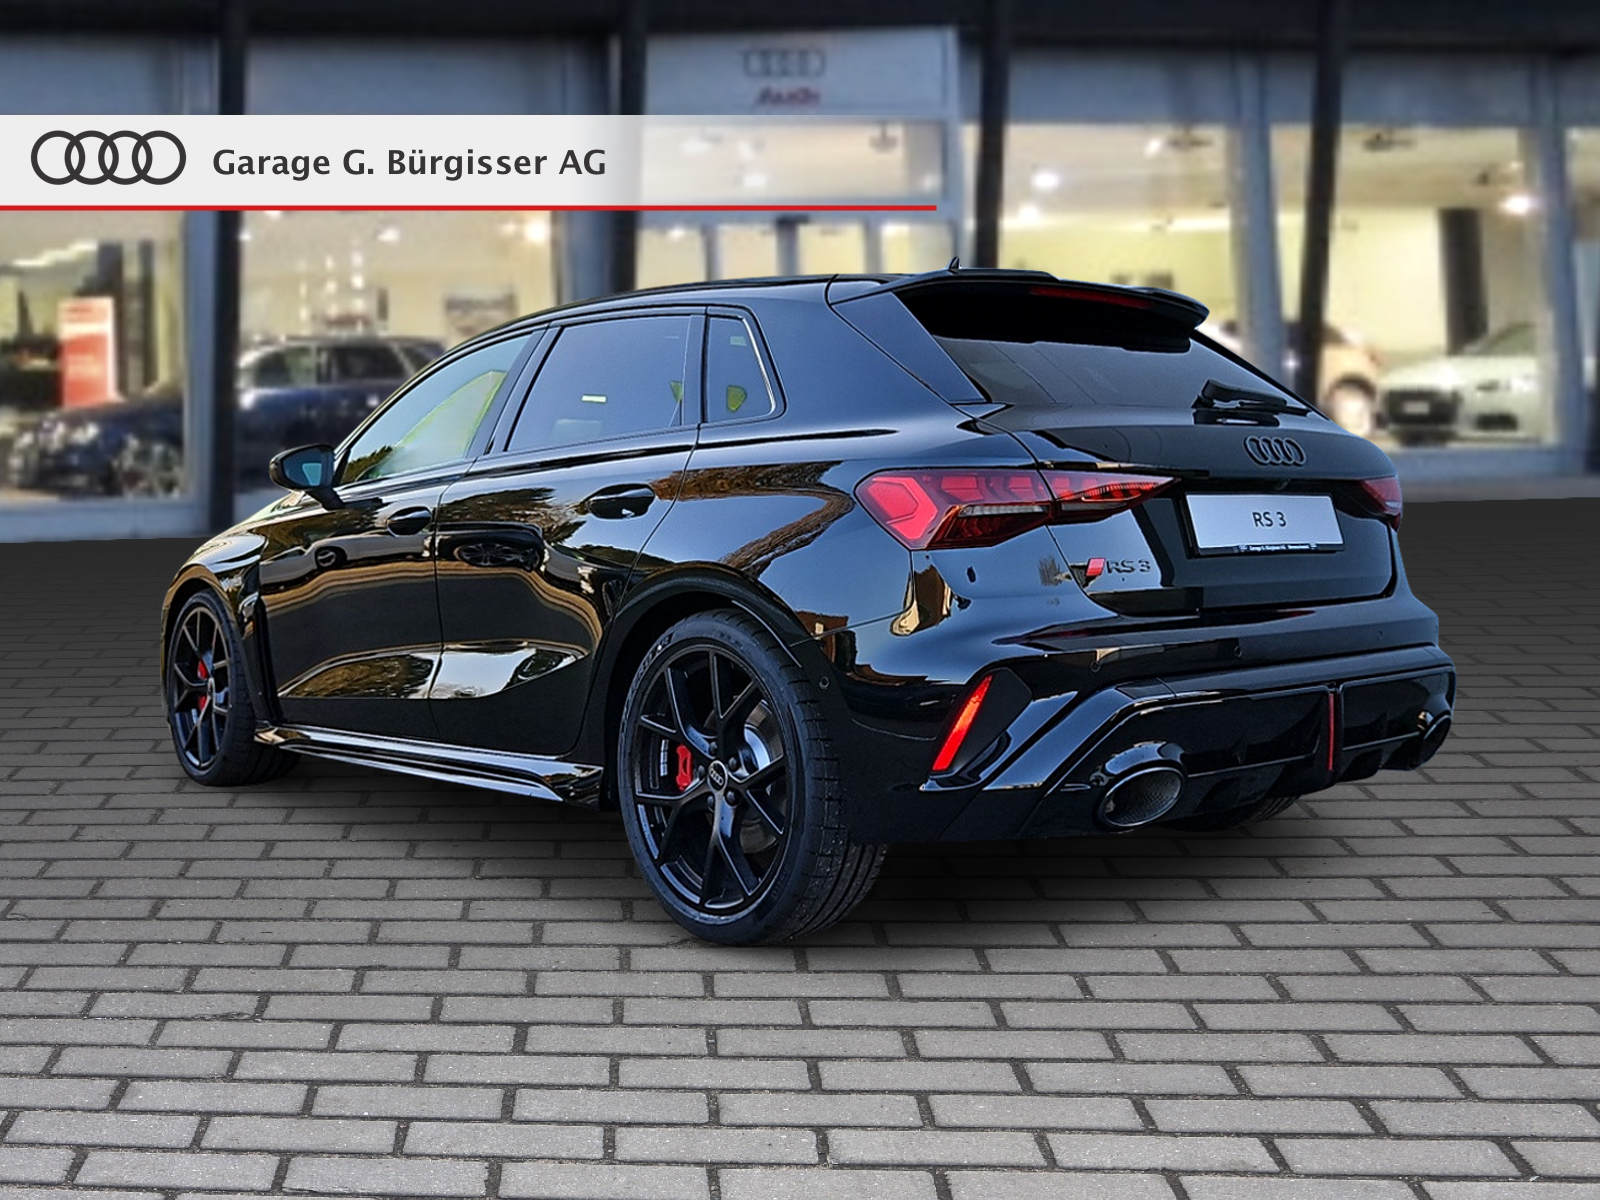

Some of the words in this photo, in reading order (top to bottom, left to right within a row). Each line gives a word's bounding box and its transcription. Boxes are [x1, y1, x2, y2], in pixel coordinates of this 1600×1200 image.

[1251, 511, 1274, 528] RS
[1275, 511, 1287, 528] 3
[1106, 560, 1136, 574] RS
[1138, 559, 1151, 573] 3
